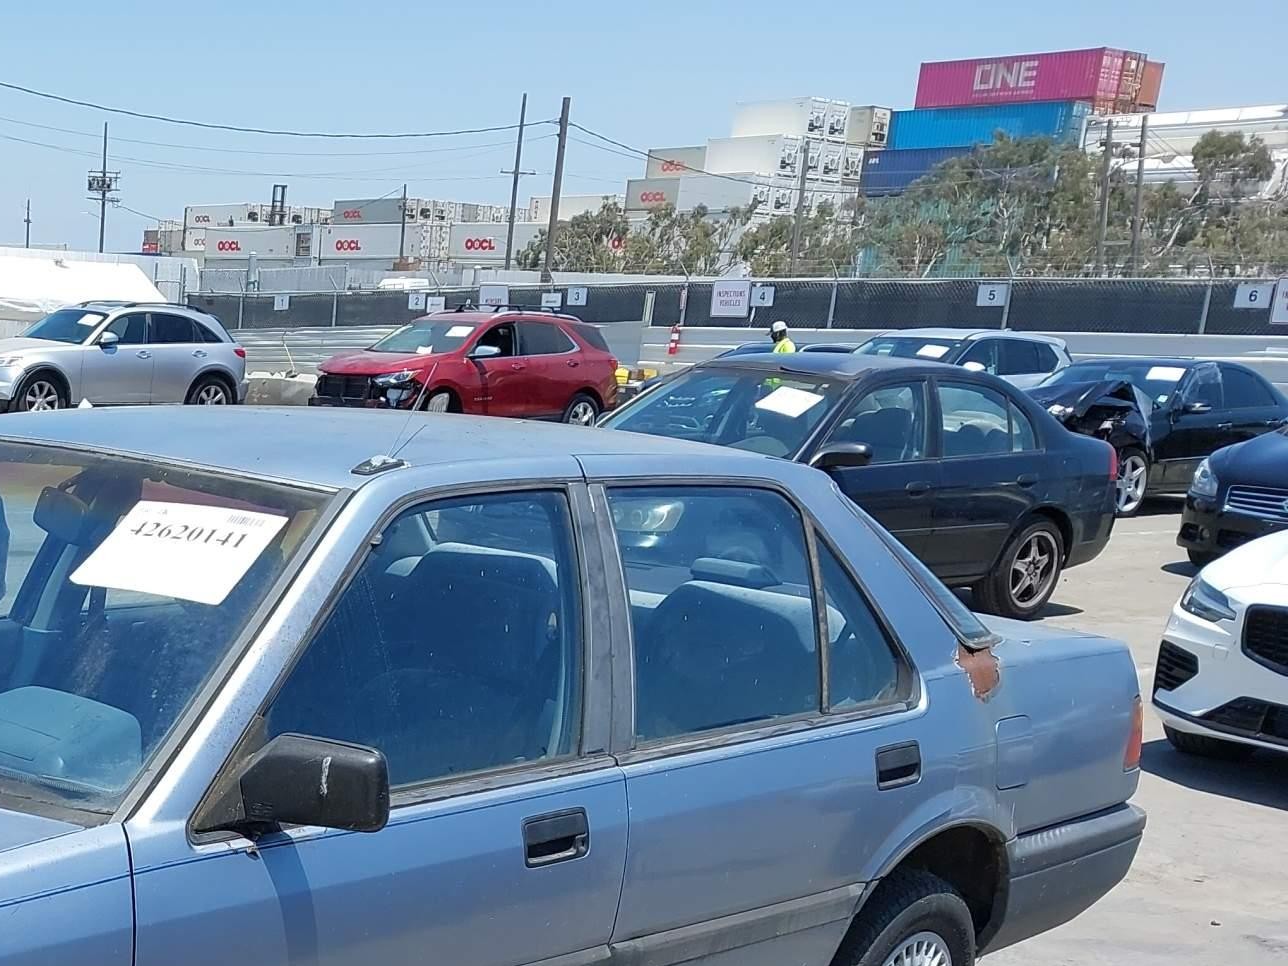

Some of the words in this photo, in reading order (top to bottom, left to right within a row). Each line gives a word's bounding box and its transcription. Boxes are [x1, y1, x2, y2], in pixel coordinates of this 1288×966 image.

[973, 60, 1039, 90] ONE
[640, 190, 666, 203] OOCL
[195, 215, 210, 223] OOCL
[343, 210, 362, 219] OOCL
[217, 240, 241, 251] OOCL
[335, 240, 362, 251] OOCL
[464, 239, 495, 251] OOCL
[574, 291, 580, 301] 3
[759, 291, 766, 301] 4
[987, 289, 997, 301] 5
[1248, 289, 1258, 303] 6
[414, 296, 420, 306] 2
[130, 520, 248, 548] 42620141
